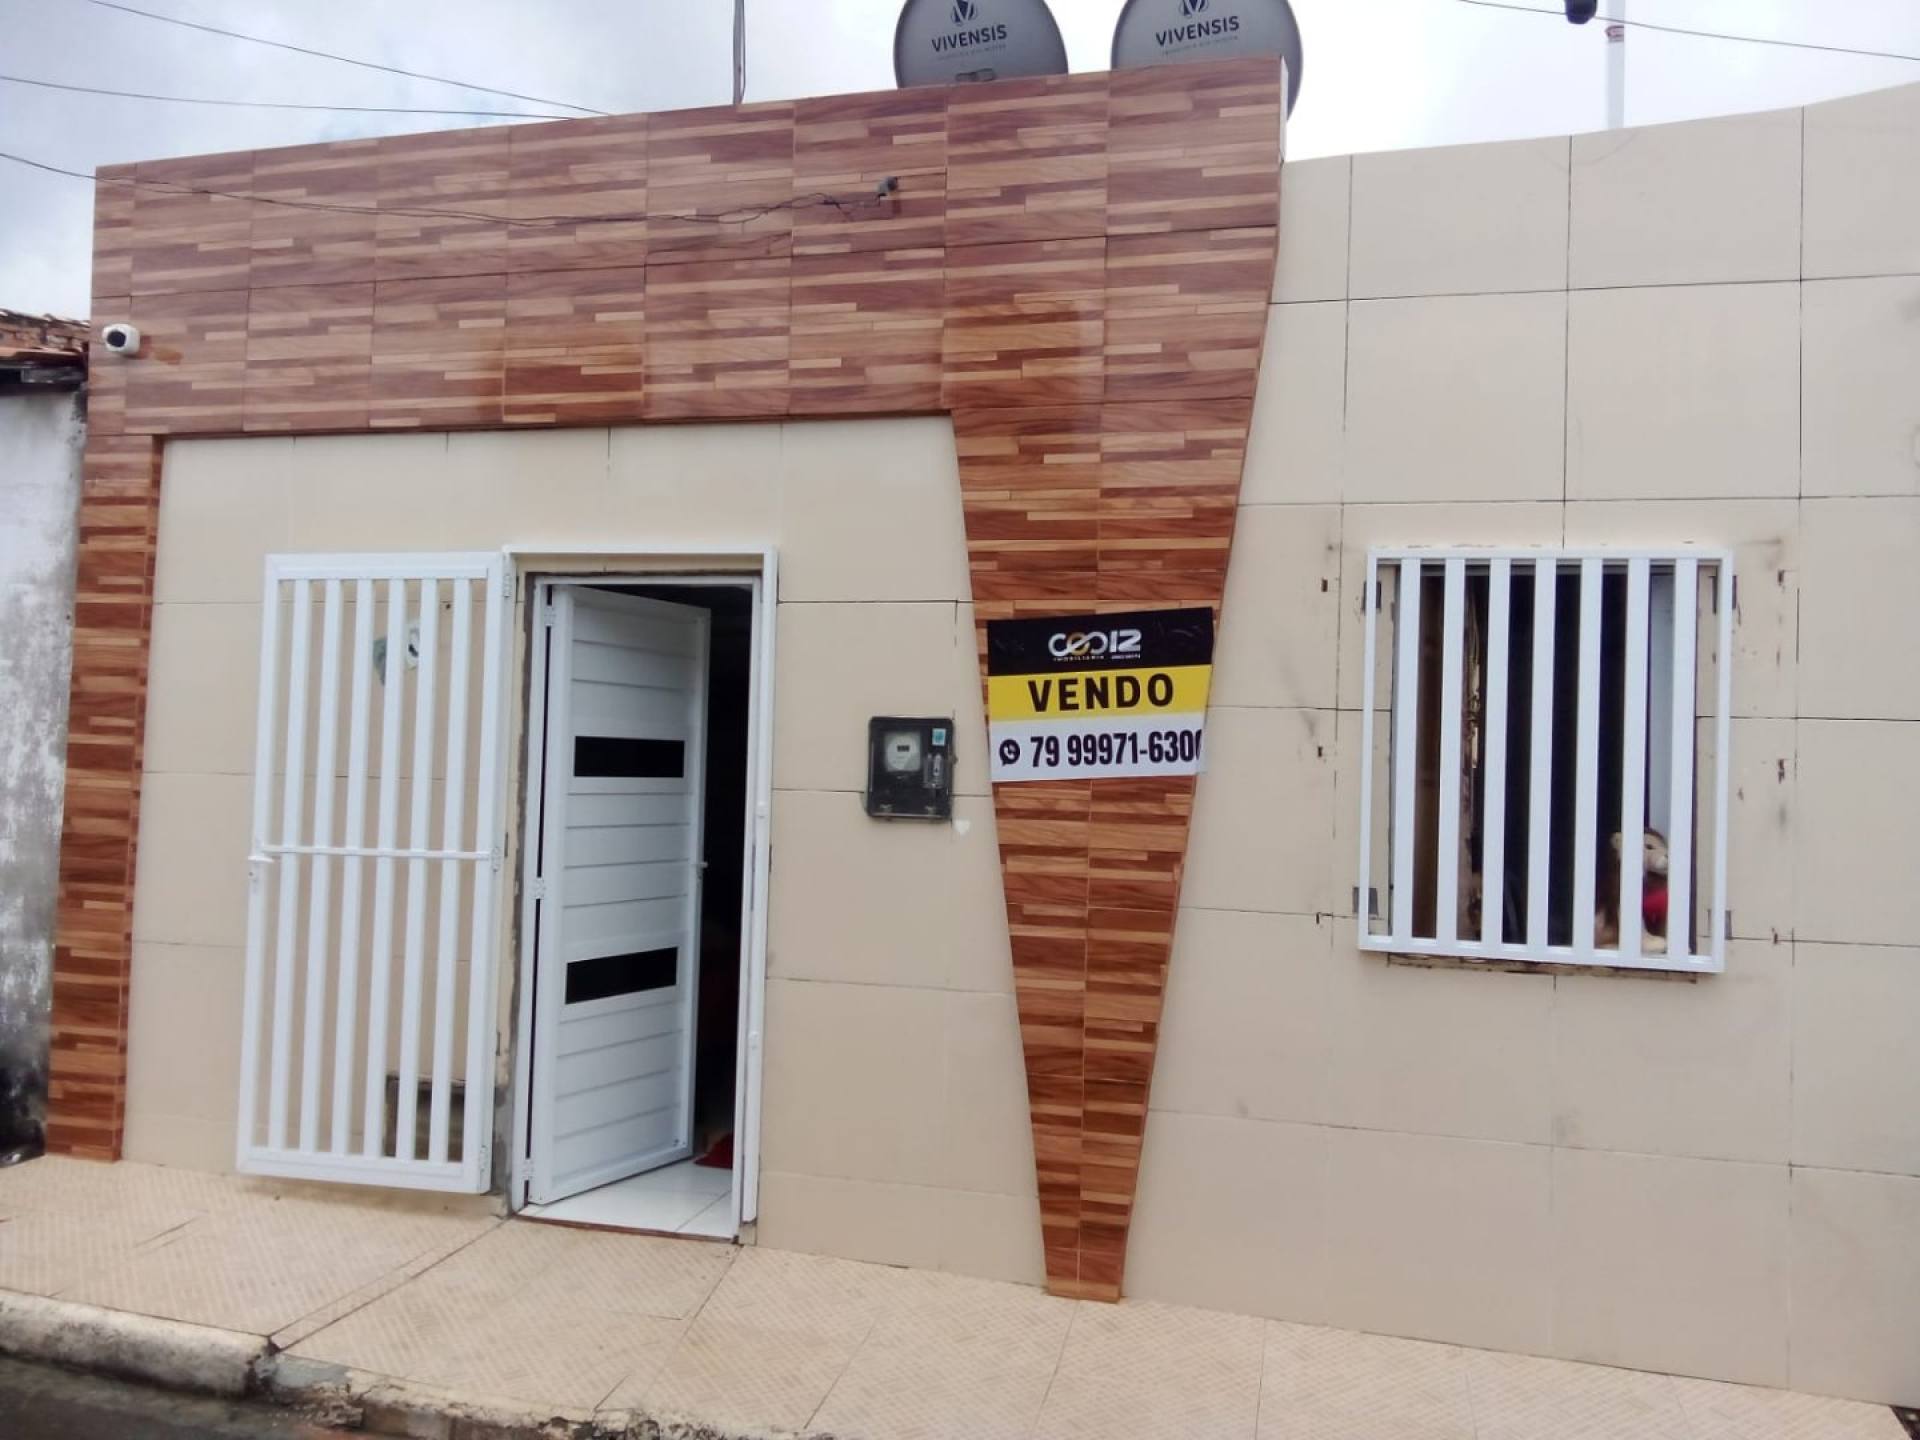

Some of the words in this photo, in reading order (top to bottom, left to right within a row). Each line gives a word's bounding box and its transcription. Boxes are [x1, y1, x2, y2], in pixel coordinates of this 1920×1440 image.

[931, 24, 1008, 53] VIVENSIS
[1155, 15, 1240, 46] VIVENSIS
[1028, 673, 1174, 712] VENDO
[1031, 736, 1060, 768] 79
